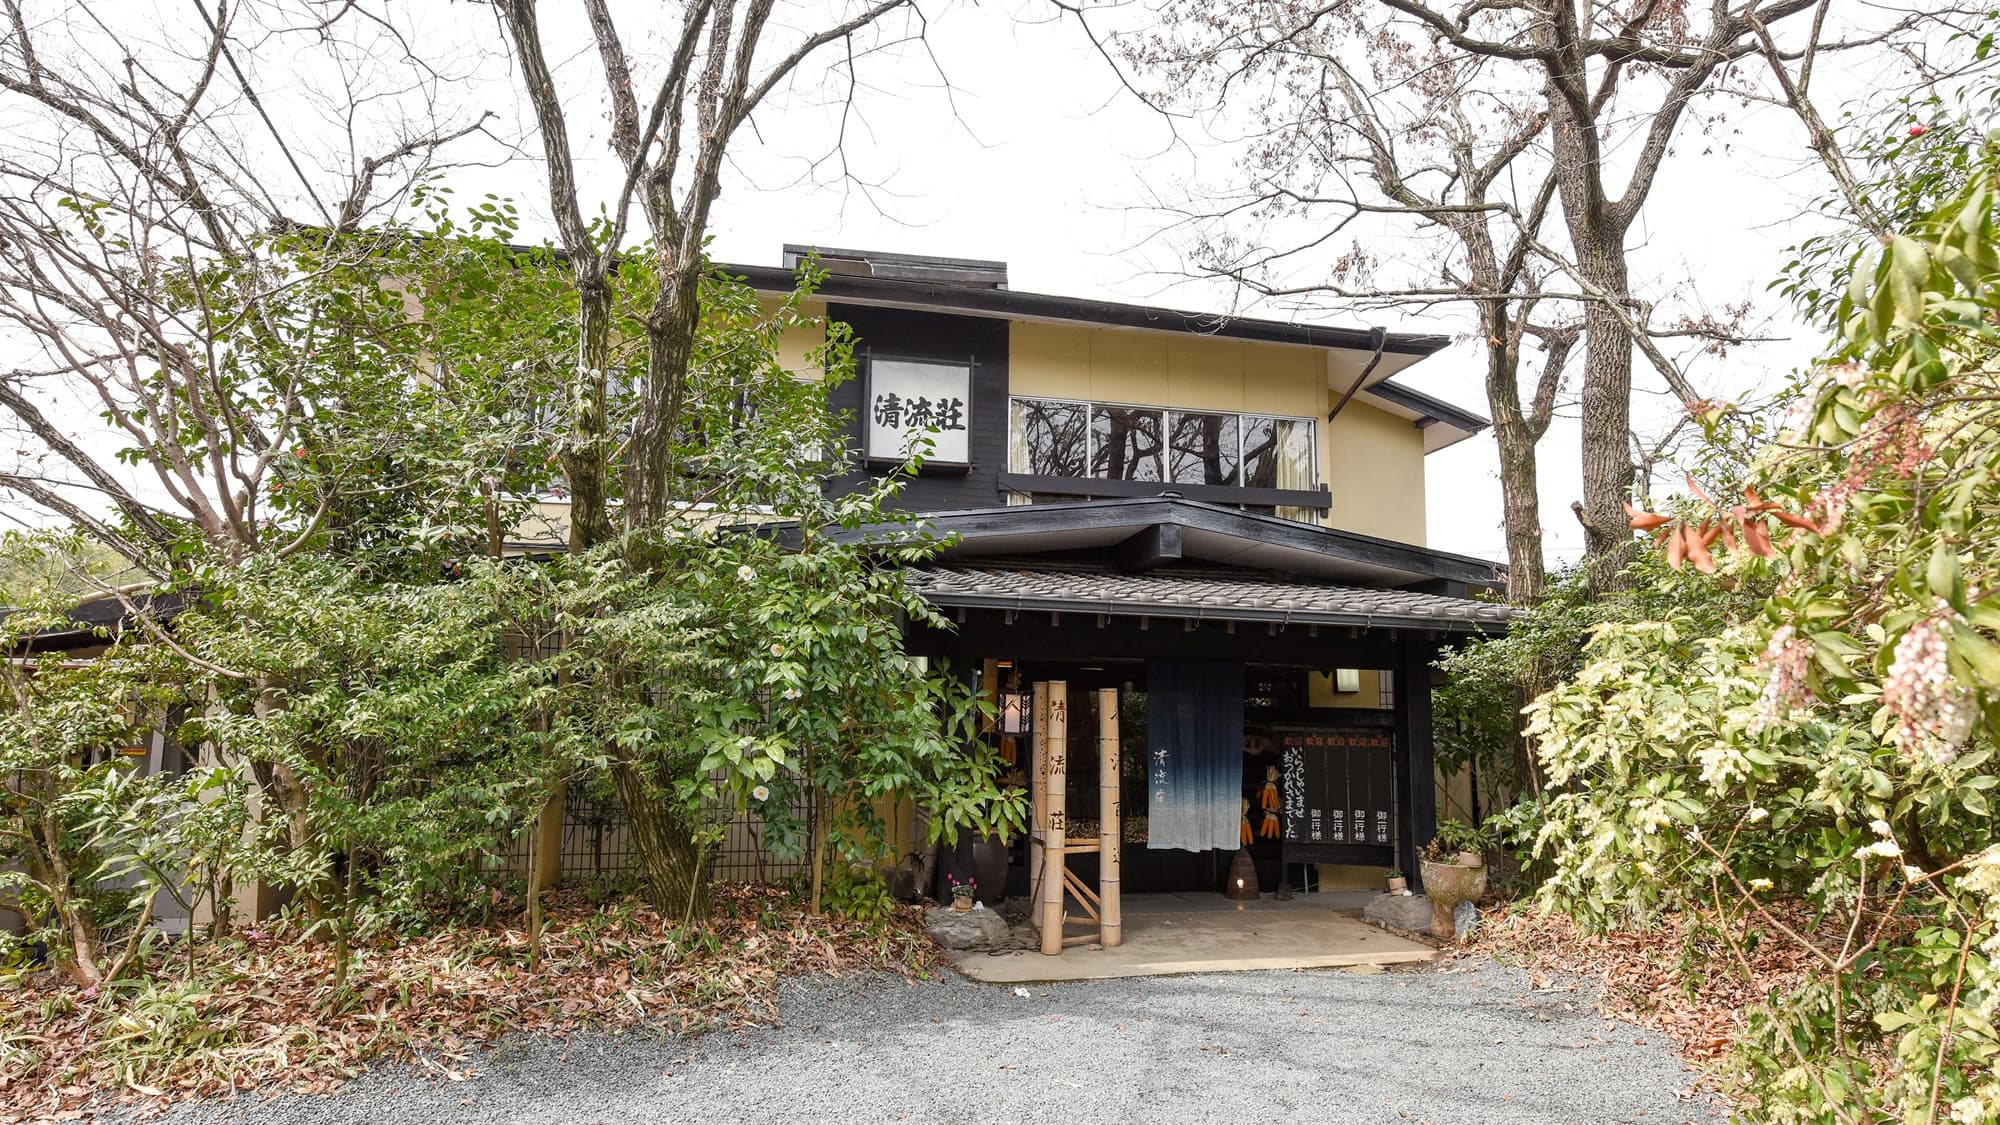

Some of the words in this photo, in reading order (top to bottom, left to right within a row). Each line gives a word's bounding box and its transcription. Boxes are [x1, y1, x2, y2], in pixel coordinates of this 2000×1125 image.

[874, 392, 966, 431] 清流荘
[1048, 699, 1067, 832] 清流荘
[1283, 751, 1297, 839] おつかれさまでした
[1311, 808, 1322, 840] 御一行様
[1332, 809, 1344, 841] 御一行様
[1354, 809, 1366, 841] 御一行様
[1376, 811, 1388, 842] 御一行様
